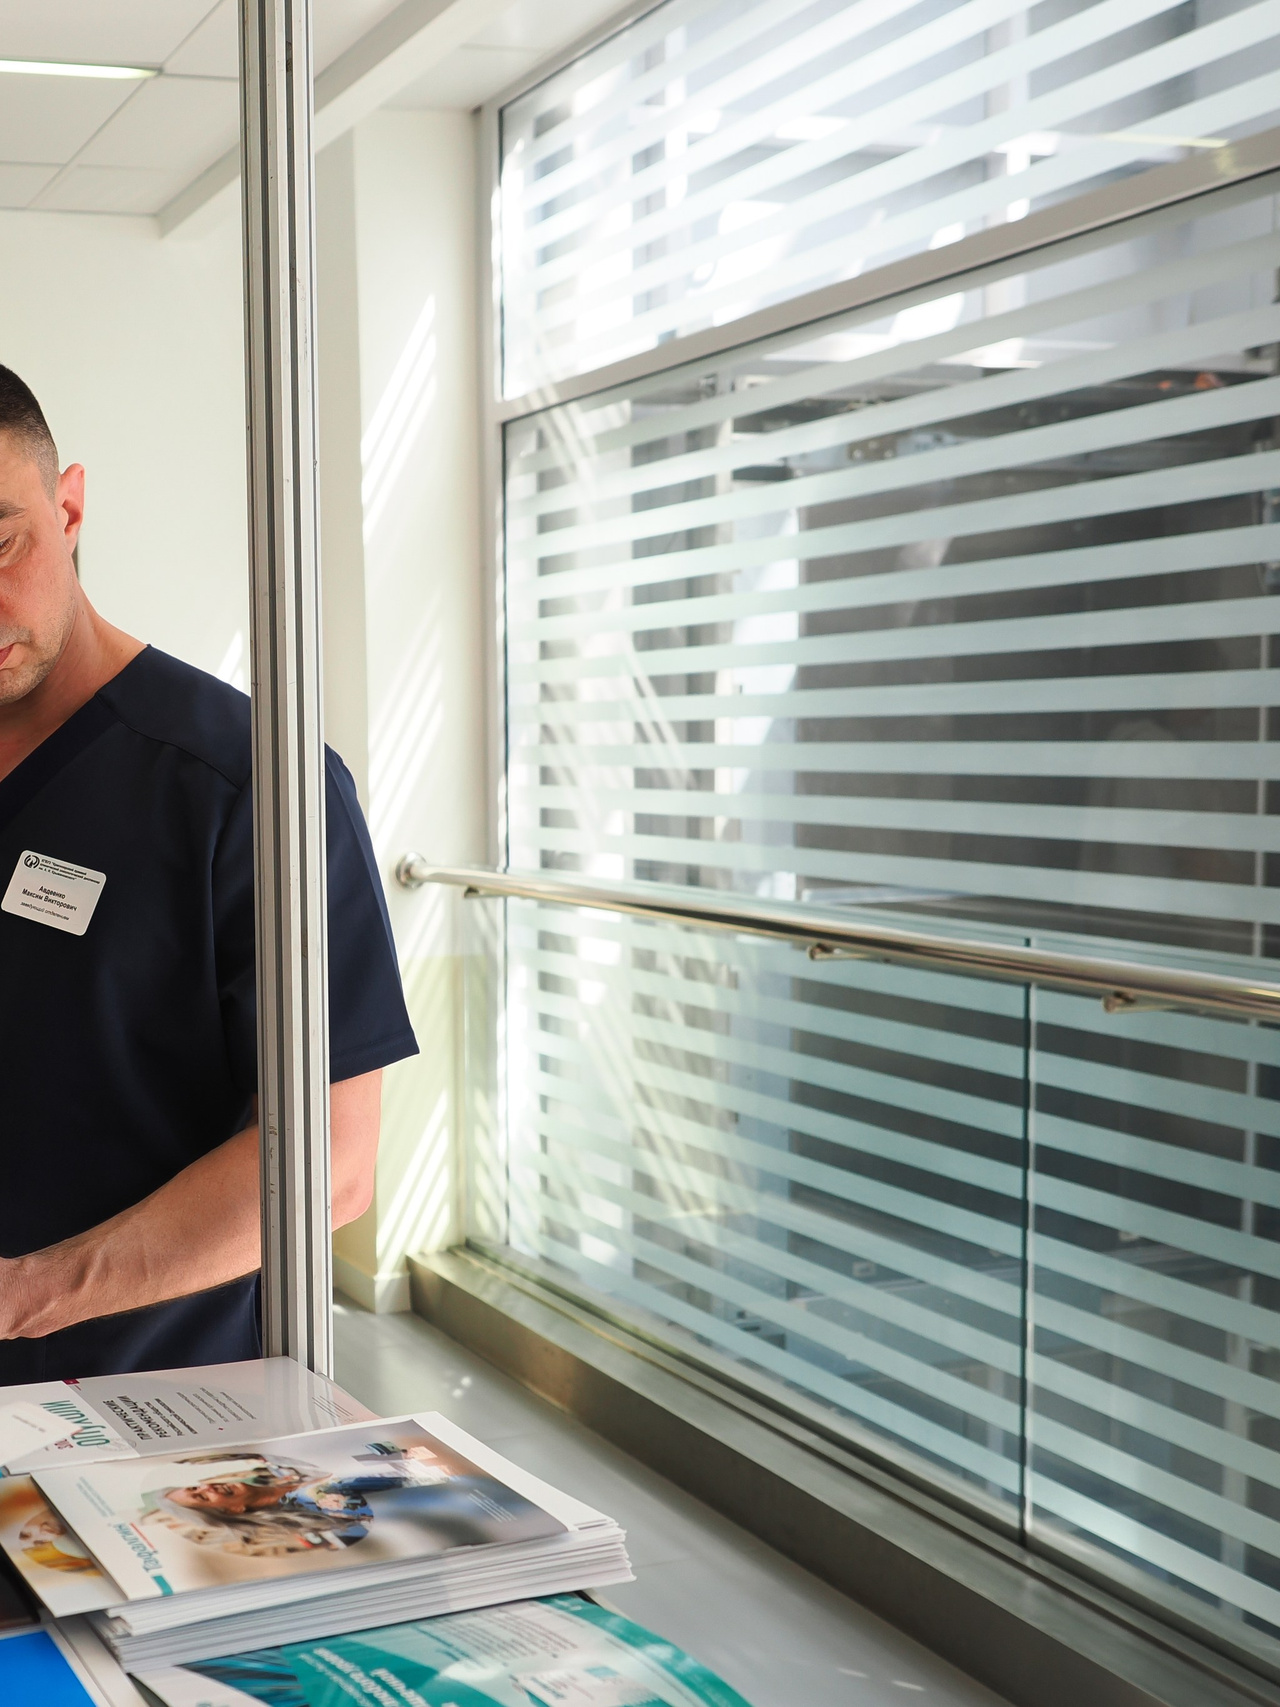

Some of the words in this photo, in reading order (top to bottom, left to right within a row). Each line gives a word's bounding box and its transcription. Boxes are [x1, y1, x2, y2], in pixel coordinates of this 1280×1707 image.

[21, 888, 44, 901] Максим
[43, 895, 78, 911] Викторович
[39, 885, 66, 900] Авдеенко
[103, 1400, 153, 1440] ПРАКТИЧЕСКИЕ
[117, 1395, 172, 1438] РЕКОМЕНДАЦИИ
